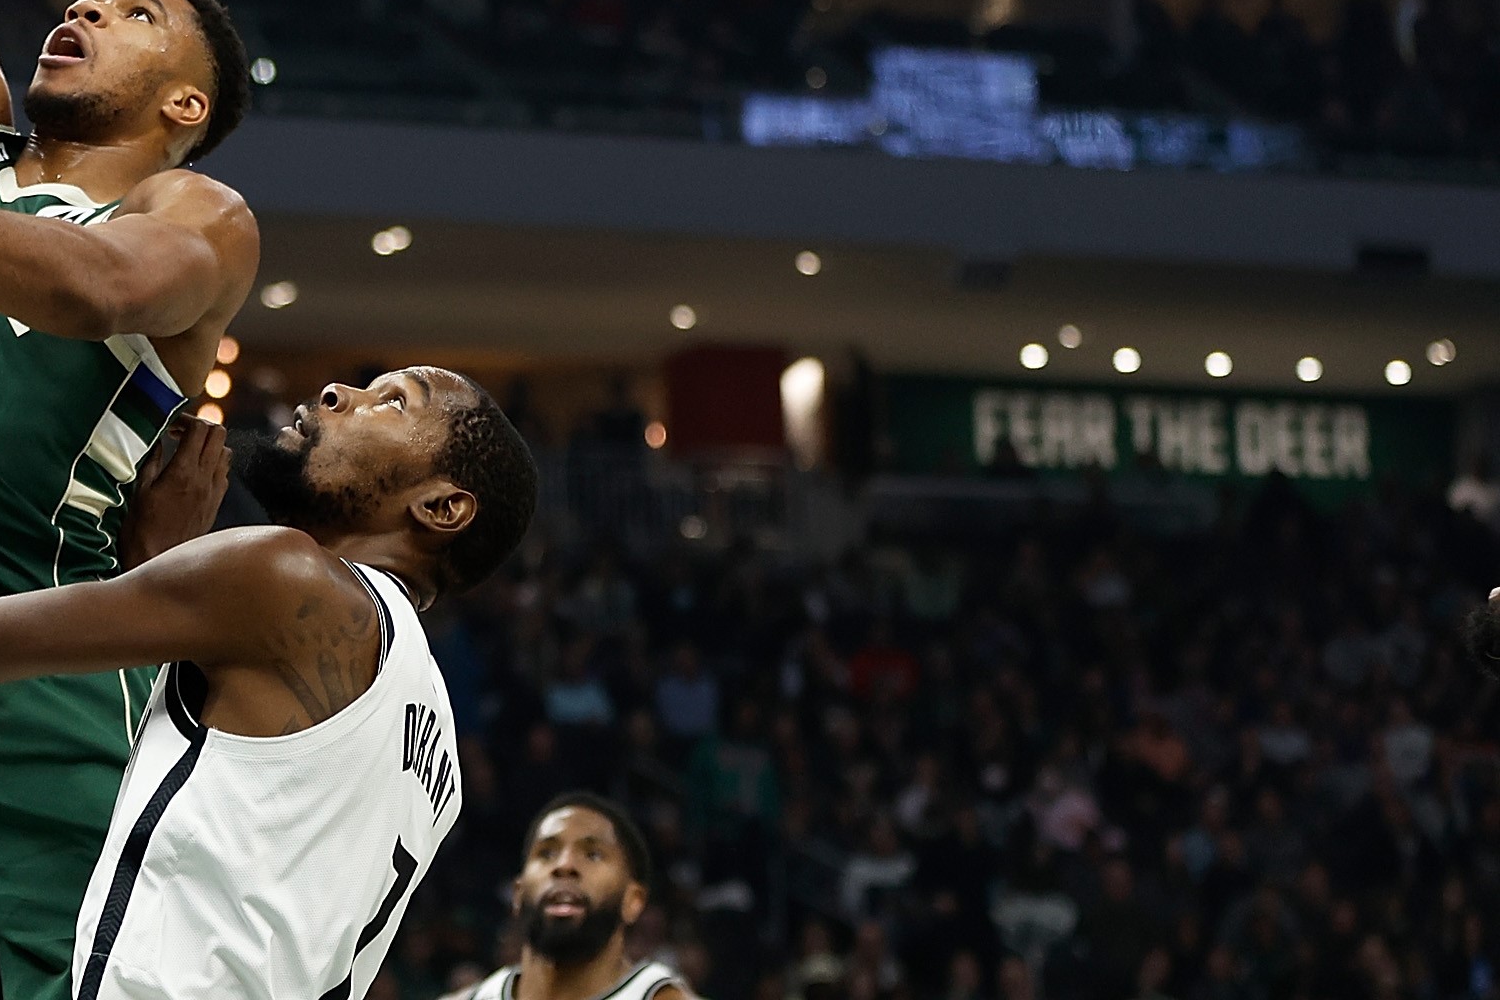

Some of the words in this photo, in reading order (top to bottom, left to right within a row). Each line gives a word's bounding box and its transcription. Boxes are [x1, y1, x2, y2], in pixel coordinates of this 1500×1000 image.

[973, 392, 1119, 471] FEAR
[1127, 396, 1229, 475] THE
[1233, 402, 1372, 480] DEER
